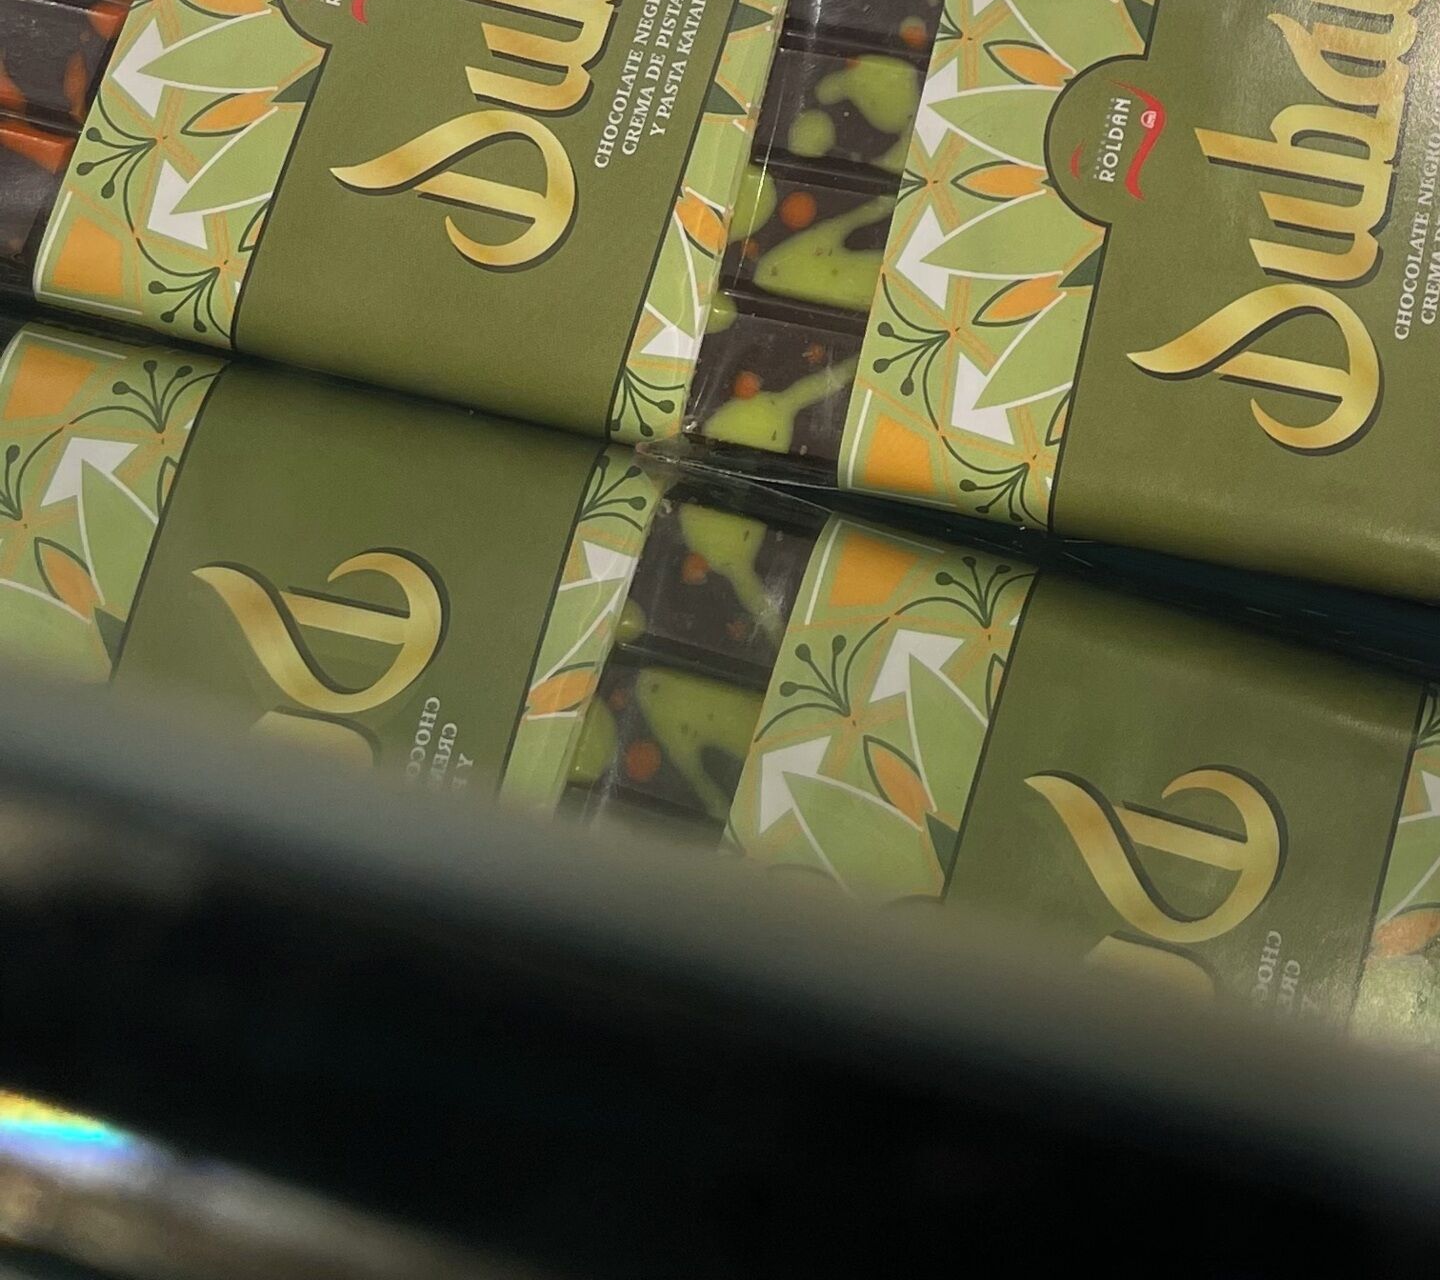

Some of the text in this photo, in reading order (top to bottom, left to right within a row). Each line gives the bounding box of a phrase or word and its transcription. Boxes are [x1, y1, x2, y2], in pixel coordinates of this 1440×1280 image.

[595, 50, 643, 167] CHOCOLATE
[622, 87, 655, 154] CREMA
[645, 53, 665, 80] DE
[650, 122, 665, 135] Y
[656, 61, 686, 118] PASTA
[1393, 212, 1430, 341] CHOCOLATE
